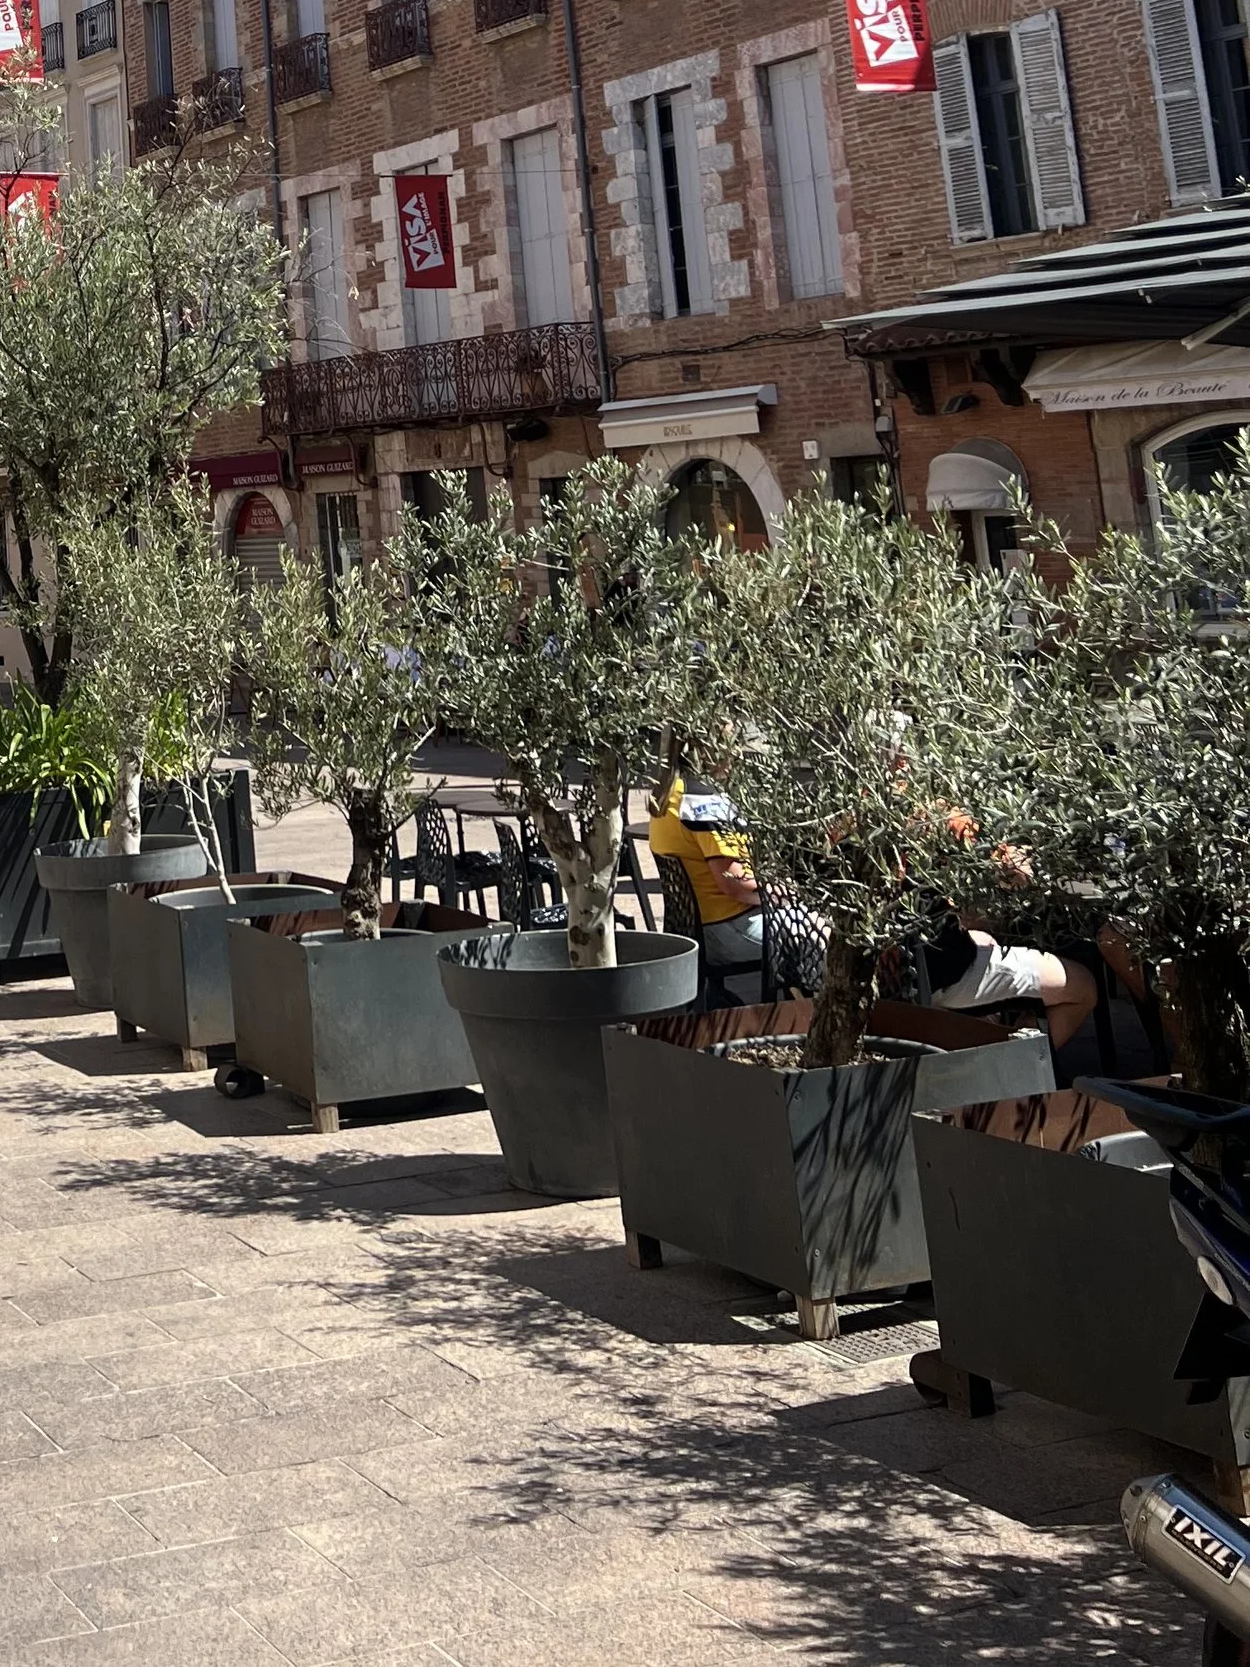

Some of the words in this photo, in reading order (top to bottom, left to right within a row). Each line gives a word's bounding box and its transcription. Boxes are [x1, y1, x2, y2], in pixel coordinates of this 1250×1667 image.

[891, 10, 908, 42] POUR
[1047, 390, 1105, 406] Maison
[1111, 388, 1131, 400] de
[1134, 387, 1150, 399] la
[302, 464, 326, 474] MAISON
[232, 476, 253, 486] MAISON
[1174, 1516, 1232, 1567] IXIL
